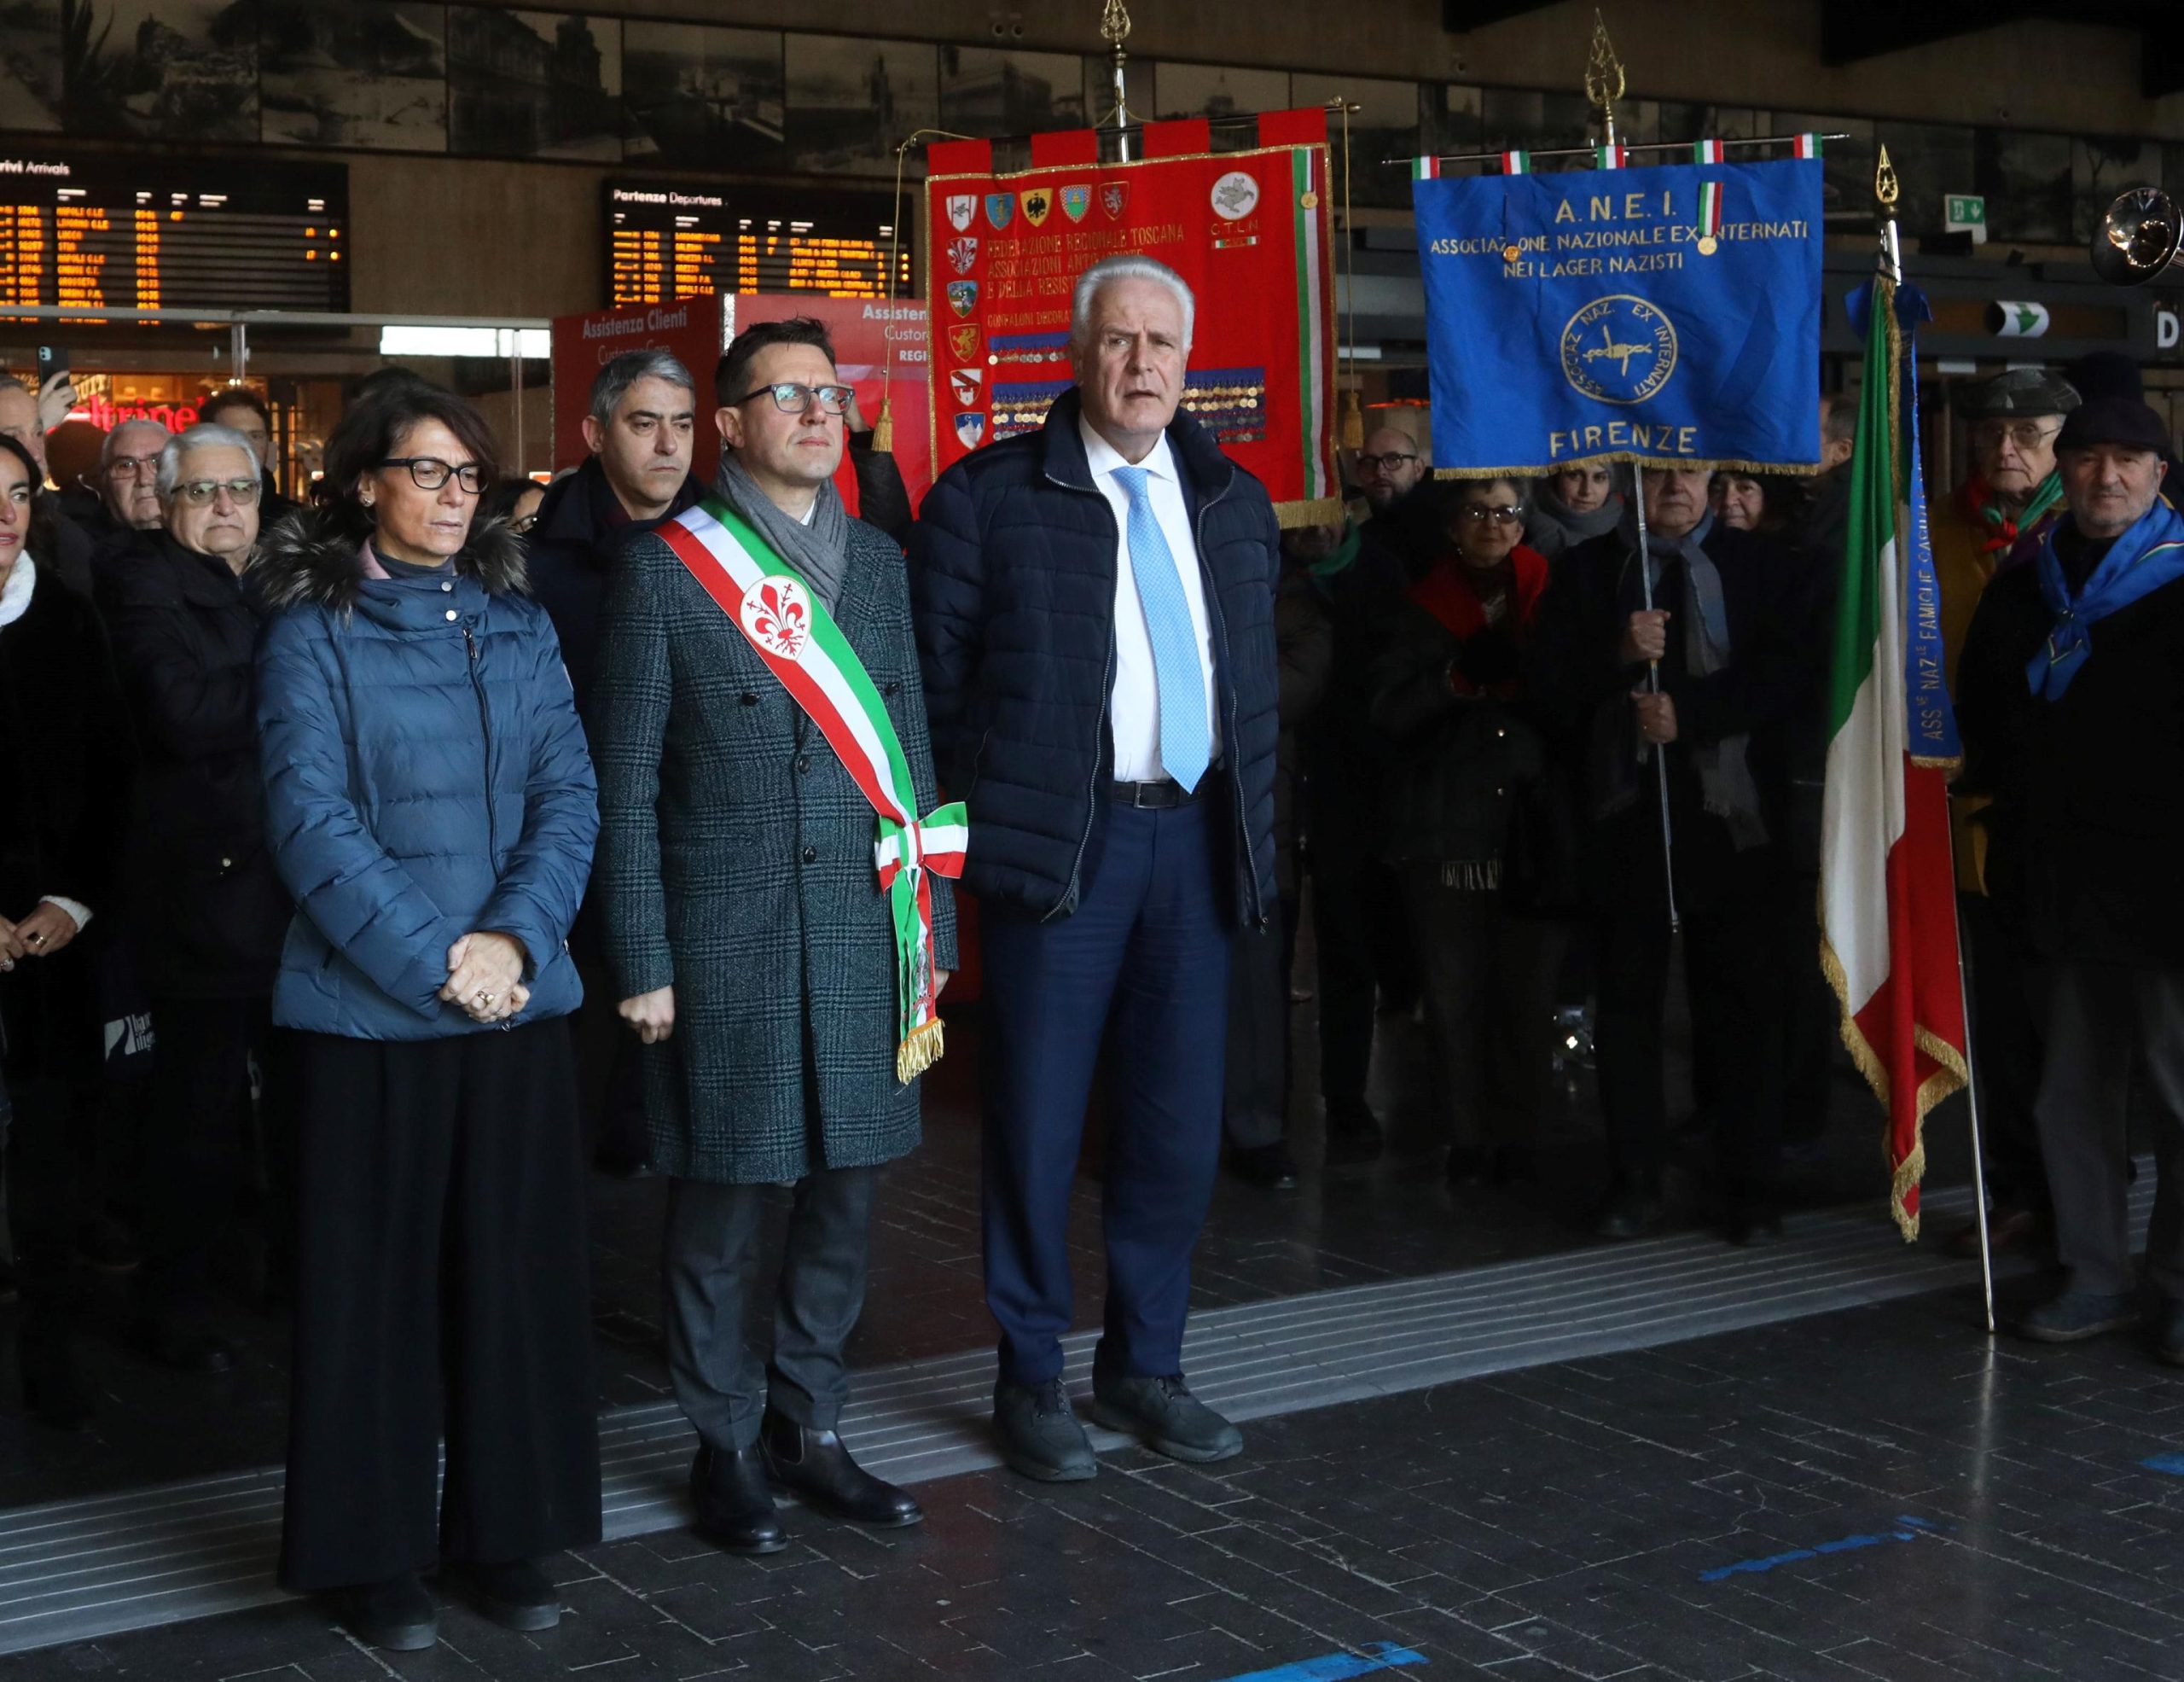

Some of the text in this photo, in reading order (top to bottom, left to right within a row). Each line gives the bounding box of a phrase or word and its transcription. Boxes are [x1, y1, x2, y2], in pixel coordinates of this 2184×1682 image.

[26, 162, 71, 176] Arrivals
[613, 189, 723, 206] Partenze Departures
[987, 224, 1184, 258] FEDERAZIONE REGIONALE TOSCANA
[1431, 236, 1550, 254] ASSOCIAZONE
[1558, 227, 1666, 250] NAZIONALE
[1715, 221, 1807, 241] NTERNATI
[987, 255, 1061, 278] ASSOCIAZIONI
[1504, 253, 1682, 279] NEI LAGER NAZISTI
[987, 282, 994, 299] E
[997, 280, 1033, 299] DELLA
[583, 306, 687, 340] Assistenza Clienti
[1632, 304, 1653, 323] EX
[2158, 311, 2179, 347] D
[1634, 326, 1672, 396] INTERNATI
[1549, 421, 1697, 457] FIRENZE
